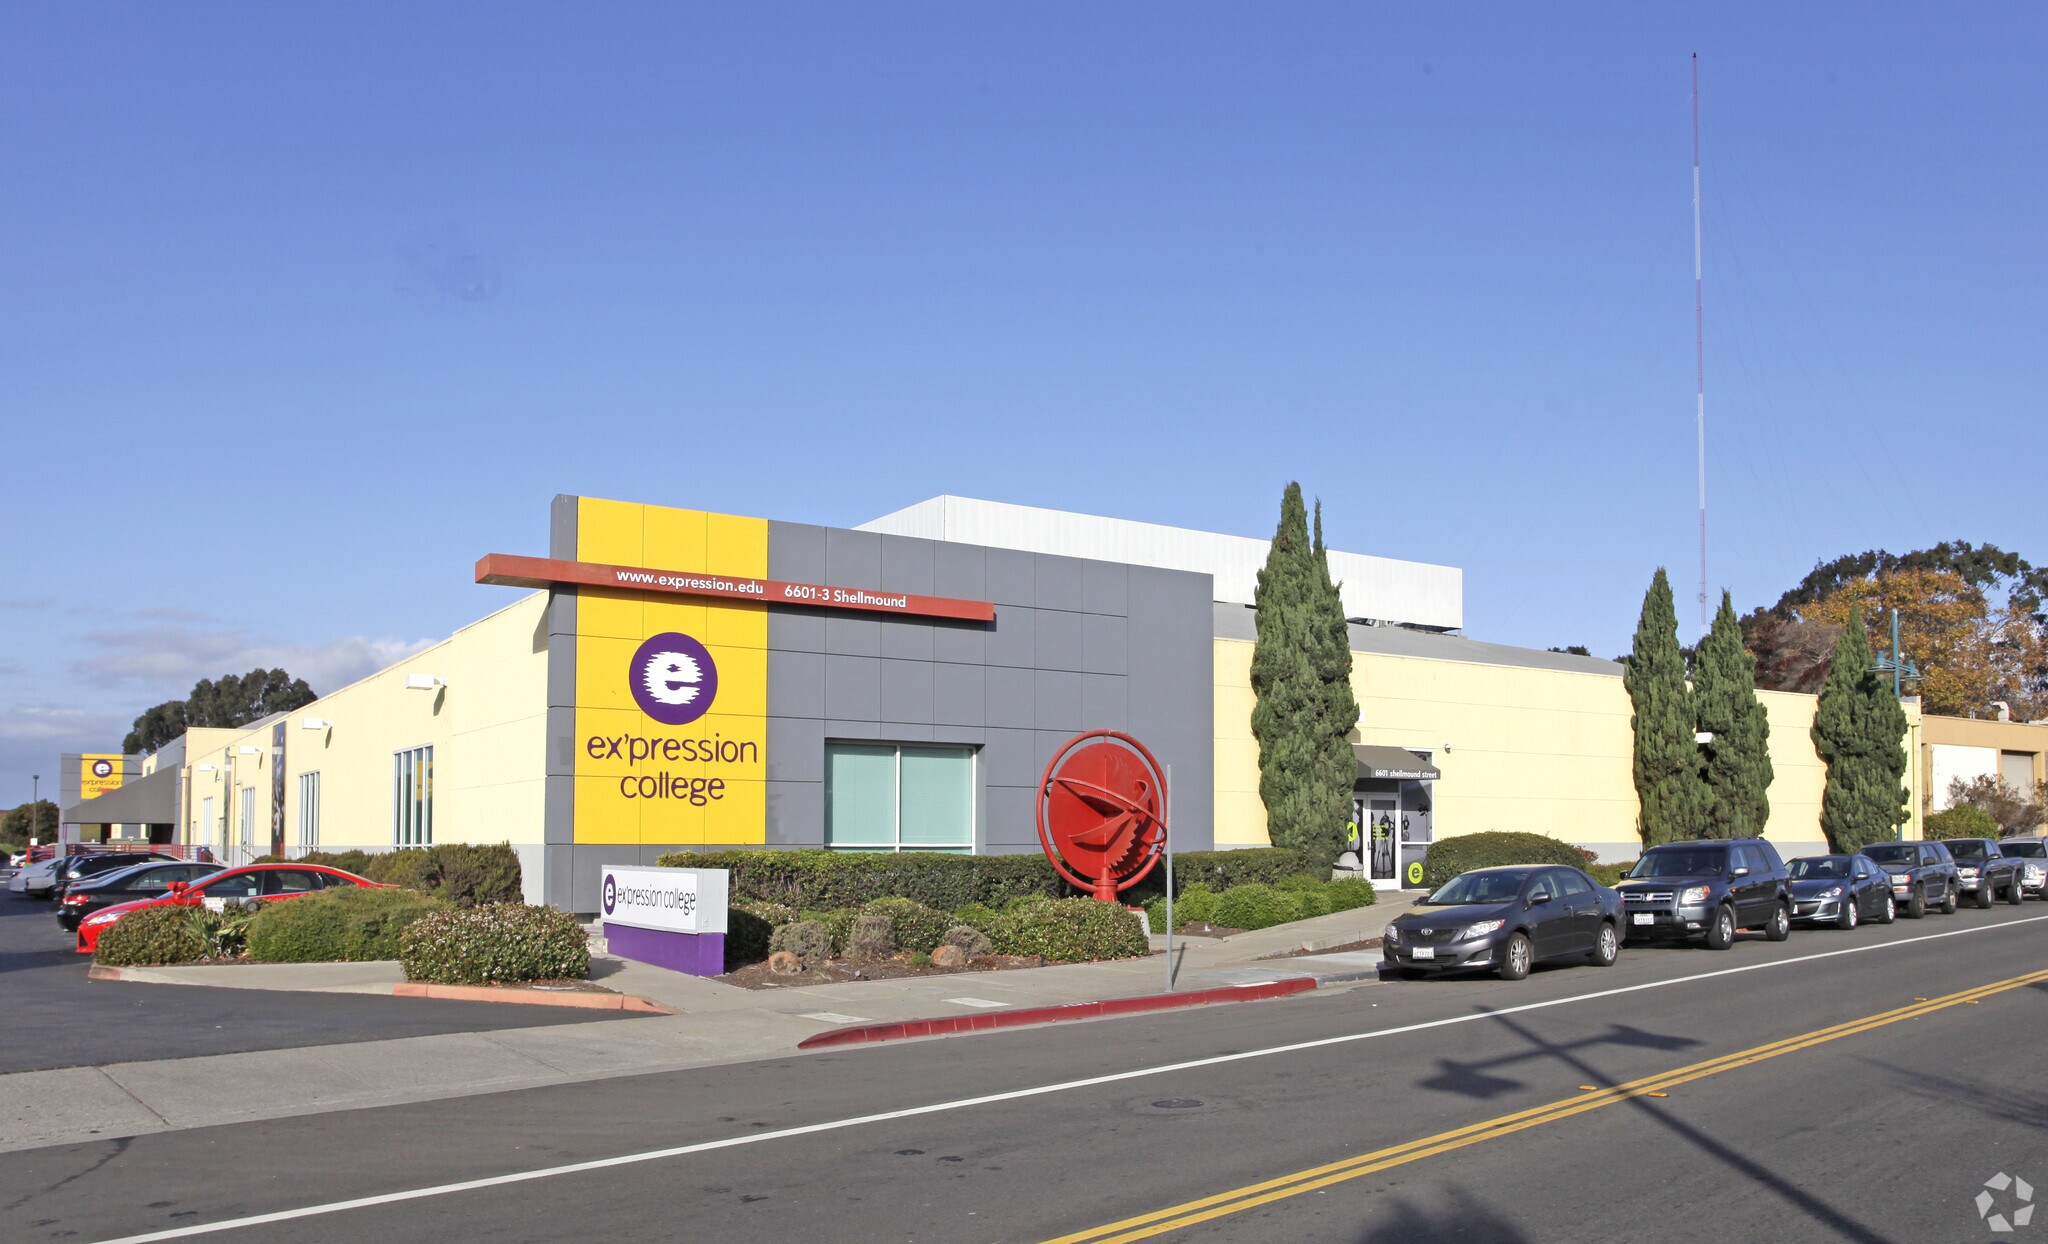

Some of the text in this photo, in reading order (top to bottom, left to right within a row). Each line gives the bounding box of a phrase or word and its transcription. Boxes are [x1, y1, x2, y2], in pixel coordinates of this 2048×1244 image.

[616, 570, 764, 595] www.expression.edu
[784, 585, 907, 608] 6601-3 Shellmound
[643, 651, 703, 705] e
[587, 733, 757, 767] ex'pression
[1375, 769, 1388, 777] 6601
[1390, 769, 1420, 778] shellmound
[620, 771, 725, 806] college
[664, 888, 696, 915] college
